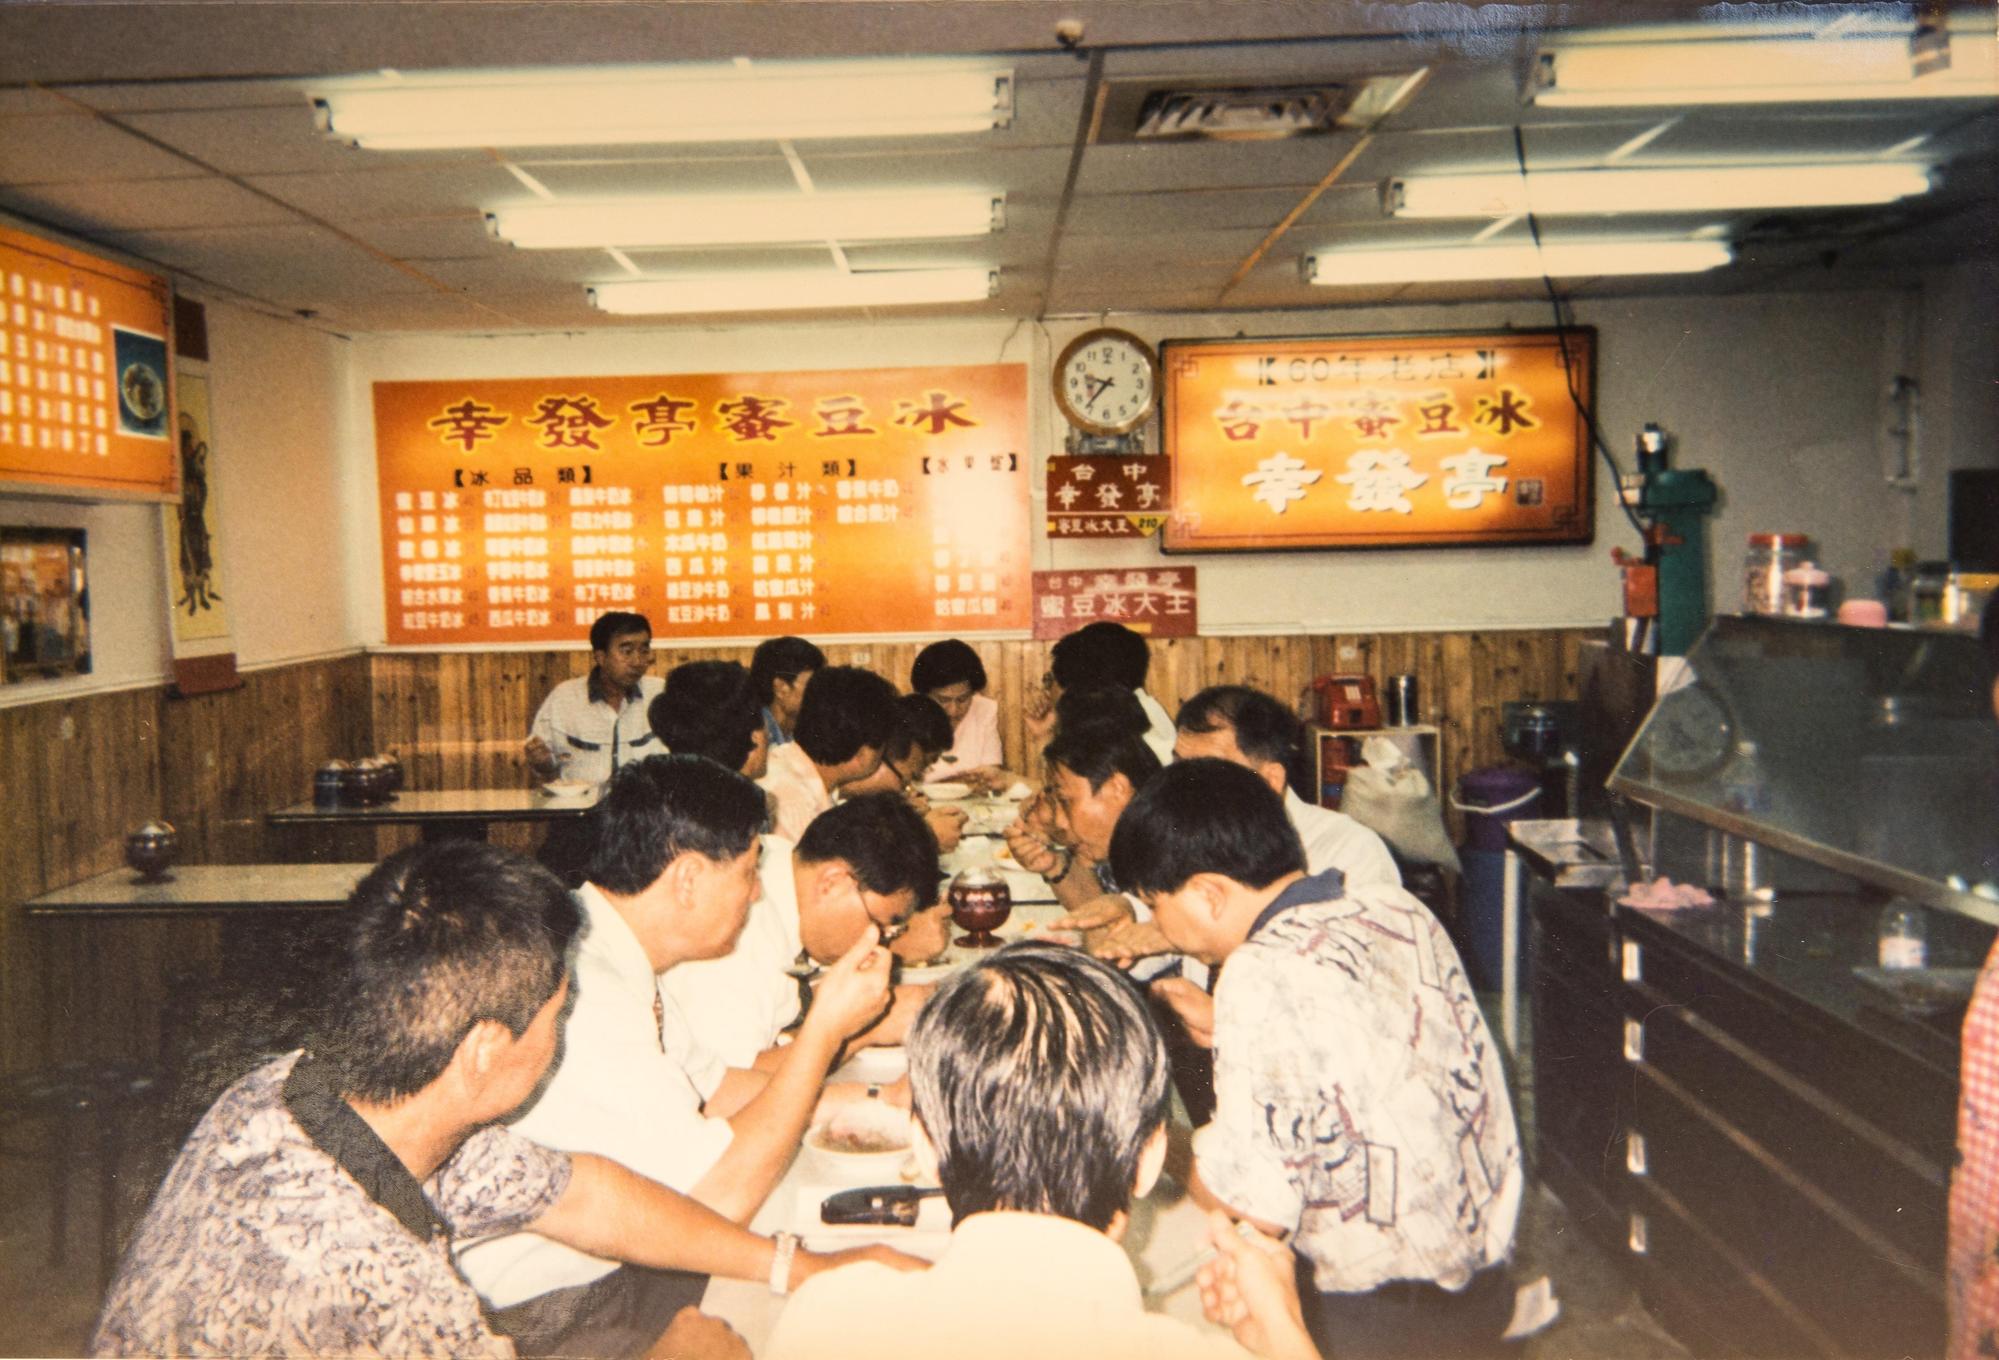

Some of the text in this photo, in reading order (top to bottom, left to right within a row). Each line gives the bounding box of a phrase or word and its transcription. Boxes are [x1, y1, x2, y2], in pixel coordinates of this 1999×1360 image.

[430, 393, 978, 451] 幸發亭蜜豆冰
[1220, 389, 1536, 439] 台中蜜豆冰
[1070, 463, 1148, 481] 台中
[1242, 446, 1510, 514] 幸發亭
[1054, 481, 1161, 510] 幸發亭
[1048, 575, 1083, 590] 台中
[1040, 592, 1191, 618] 蜜豆冰大王
